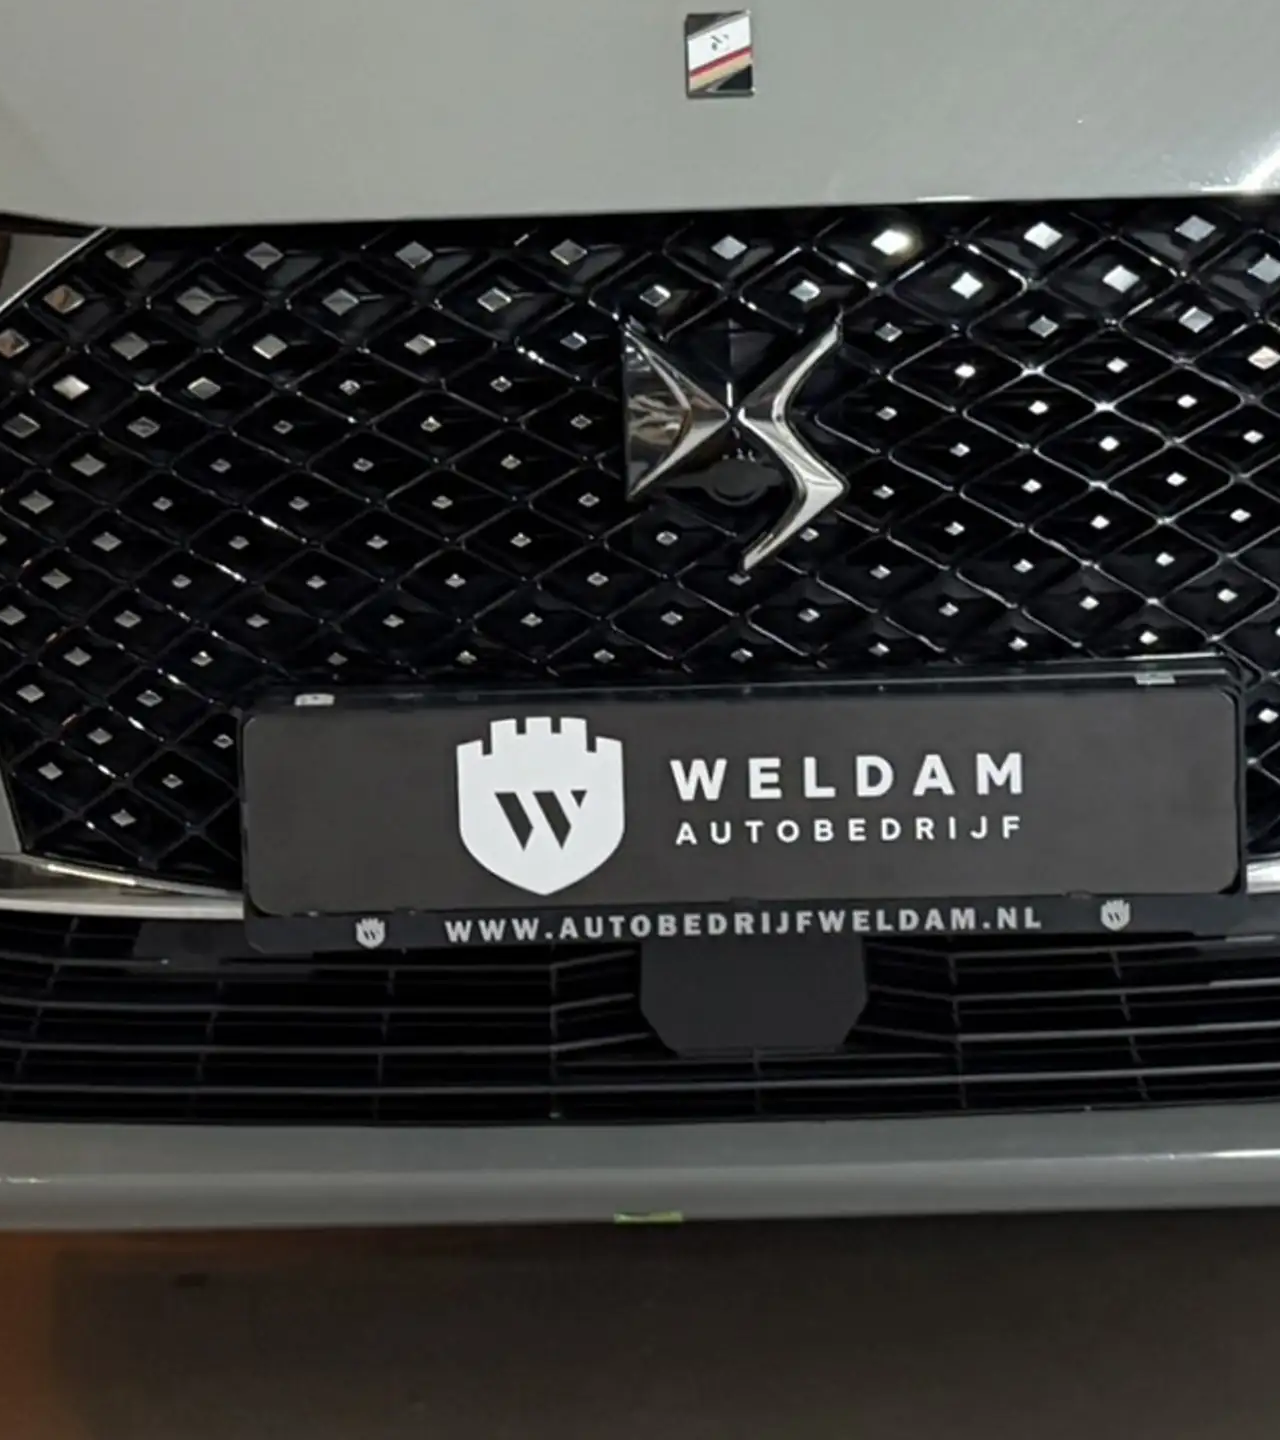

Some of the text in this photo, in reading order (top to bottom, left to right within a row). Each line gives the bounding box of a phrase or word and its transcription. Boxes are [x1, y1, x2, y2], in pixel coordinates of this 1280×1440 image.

[669, 752, 1023, 802] WELDAM
[675, 815, 1022, 846] AUTOBEDRIJF
[445, 906, 1041, 943] WWW.AUTOBEDRIJFWELDAM.NL
